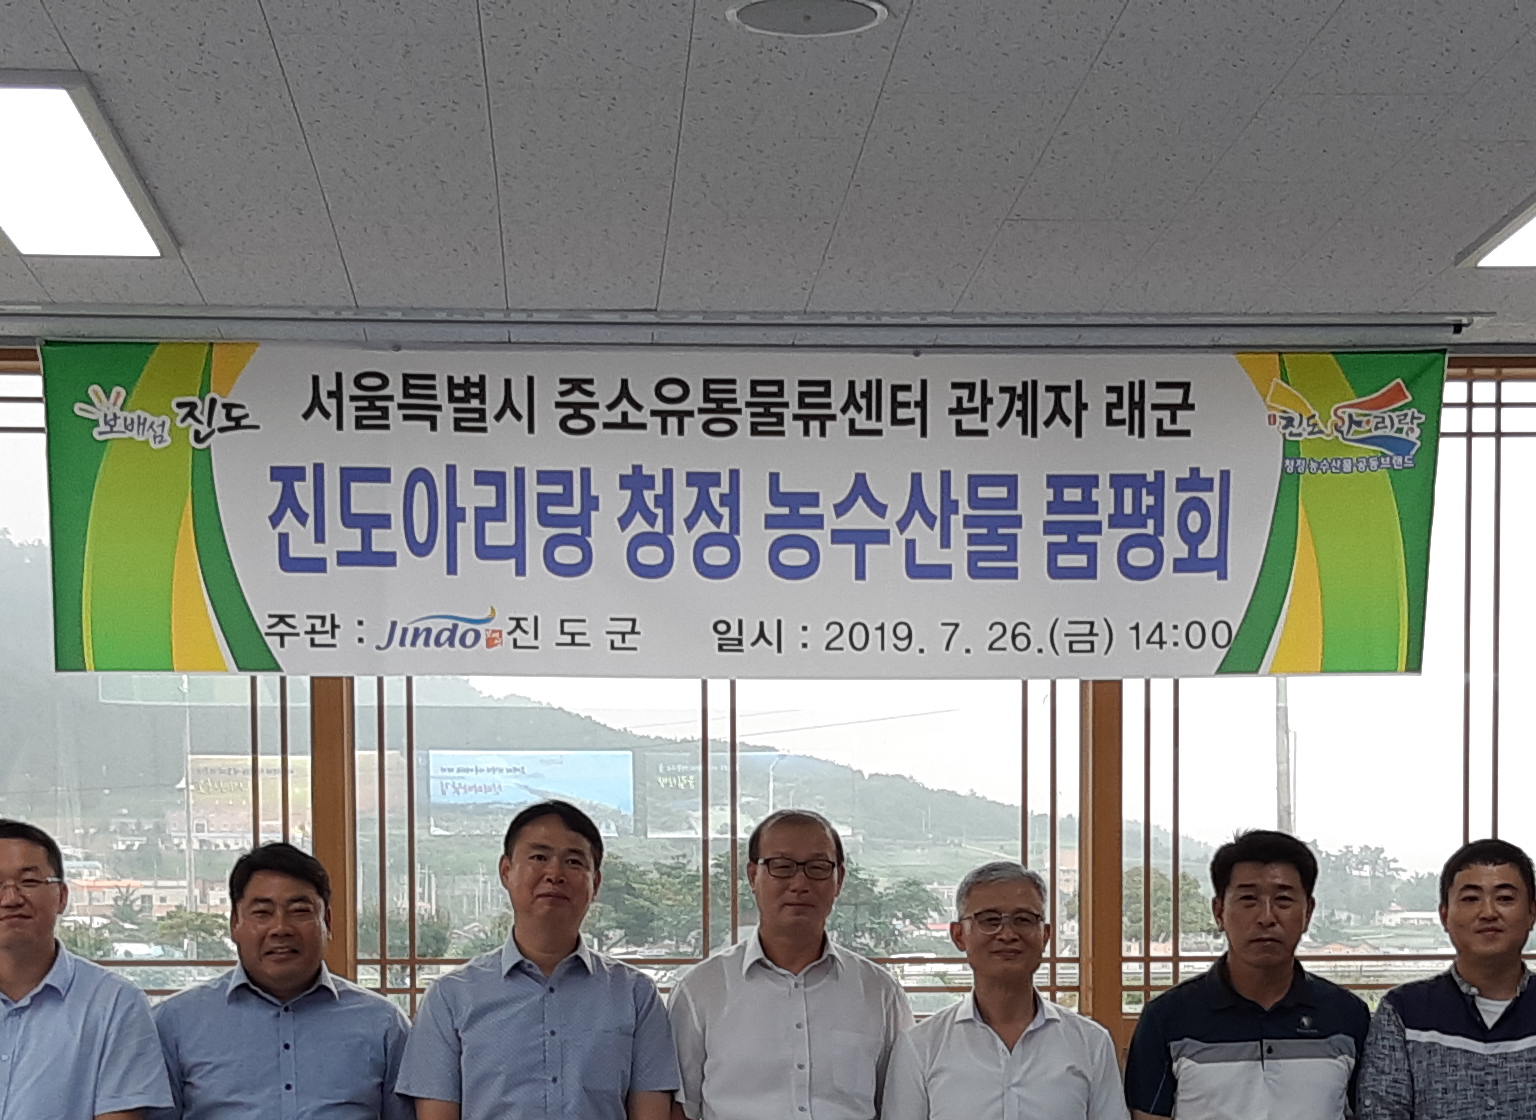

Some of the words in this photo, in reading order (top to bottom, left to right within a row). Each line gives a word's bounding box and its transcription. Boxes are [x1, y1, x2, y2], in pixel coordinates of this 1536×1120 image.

[175, 396, 261, 447] 진도
[301, 371, 537, 435] 서울특별시
[554, 374, 929, 439] 중소유통물류센터
[947, 377, 1090, 438] 관계자
[1105, 378, 1197, 438] 래군
[1308, 457, 1353, 475] 농수산물
[267, 461, 600, 578] 진도아리랑
[616, 463, 742, 581] 청정
[763, 468, 1024, 581] 농수산물
[1042, 466, 1233, 581] 품평회
[264, 611, 341, 650] 주관
[375, 617, 482, 652] Jindo
[712, 617, 784, 654] 일시
[824, 621, 926, 654] 2019.
[939, 622, 972, 654] 7.
[1128, 618, 1234, 652] 14:00
